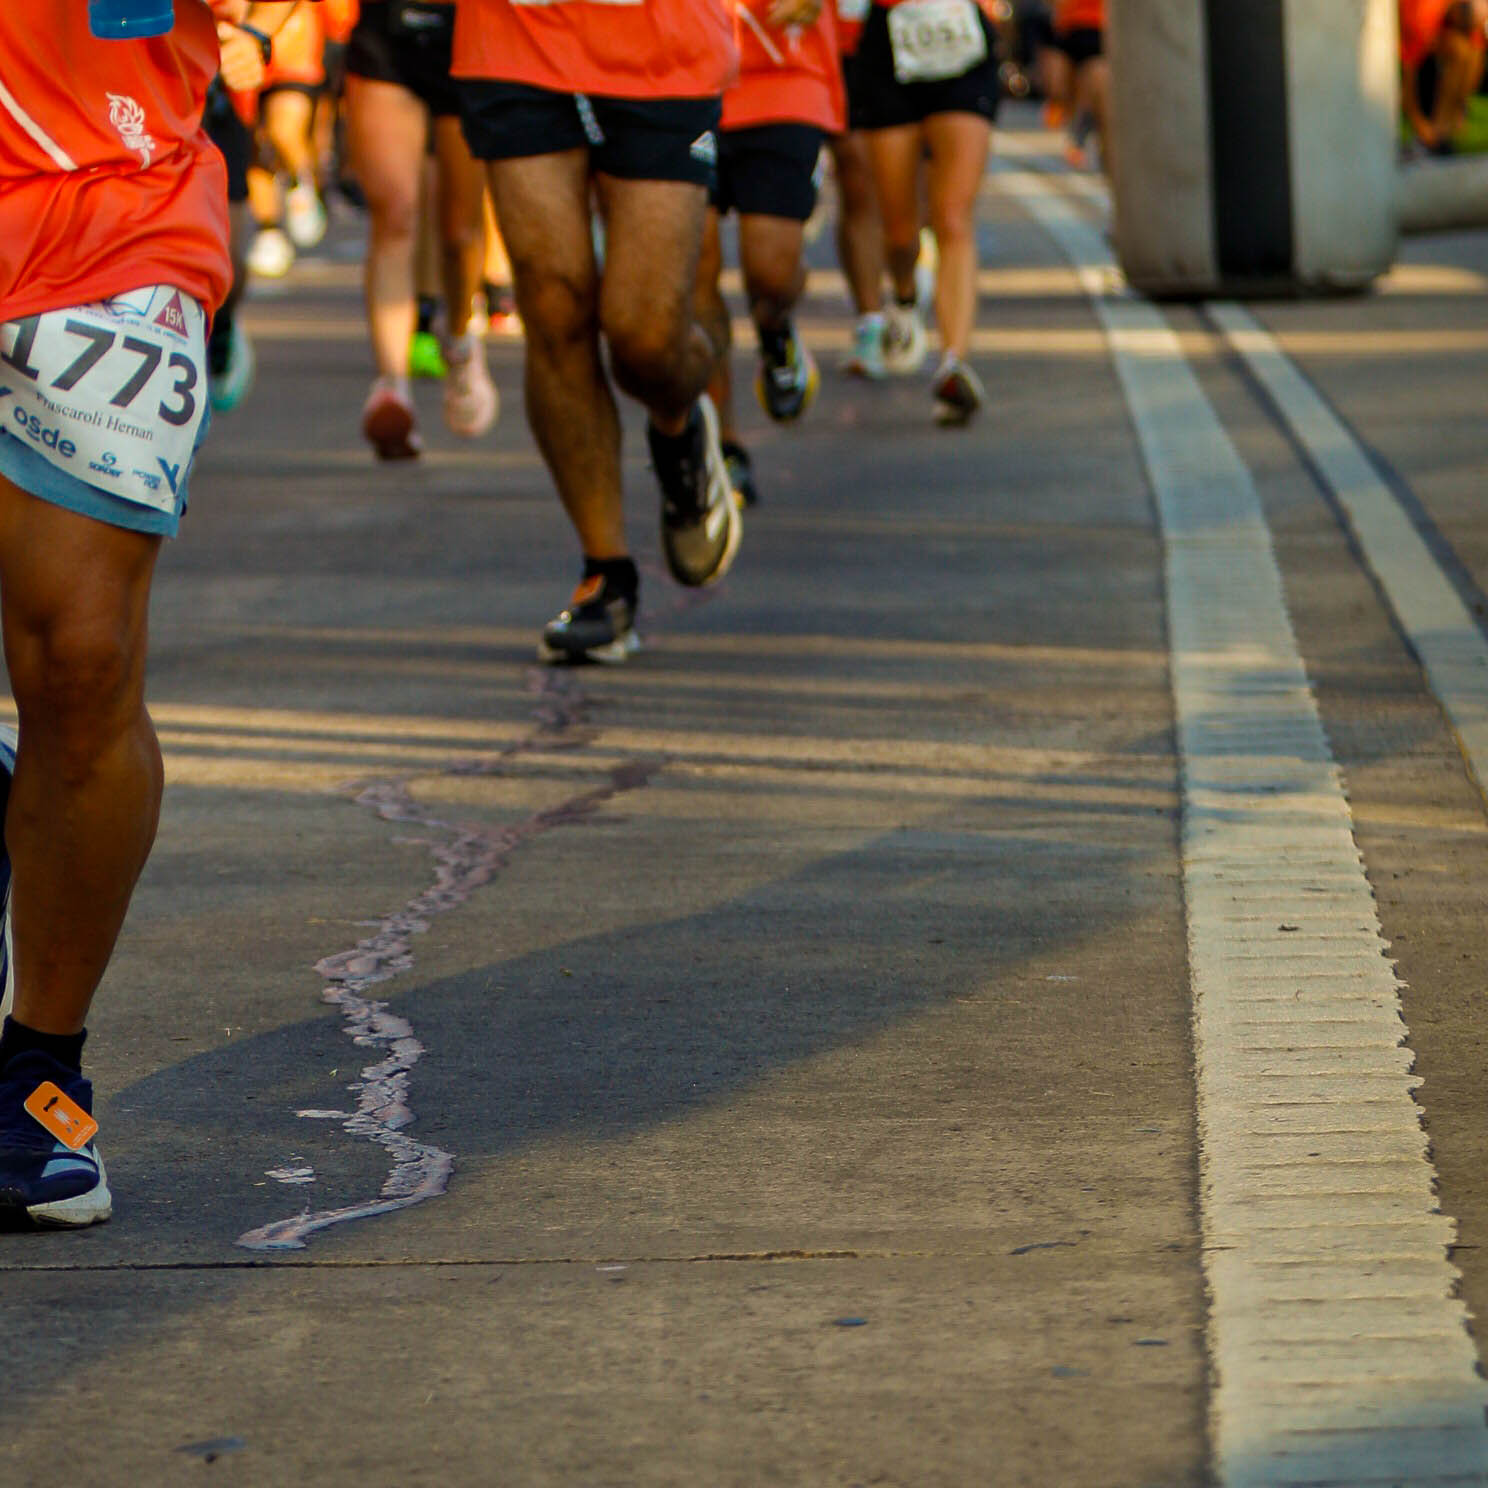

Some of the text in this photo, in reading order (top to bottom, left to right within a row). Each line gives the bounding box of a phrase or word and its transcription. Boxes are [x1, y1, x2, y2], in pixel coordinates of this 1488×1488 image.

[165, 305, 185, 331] 15K
[0, 312, 199, 427] 1773
[13, 405, 77, 458] osde
